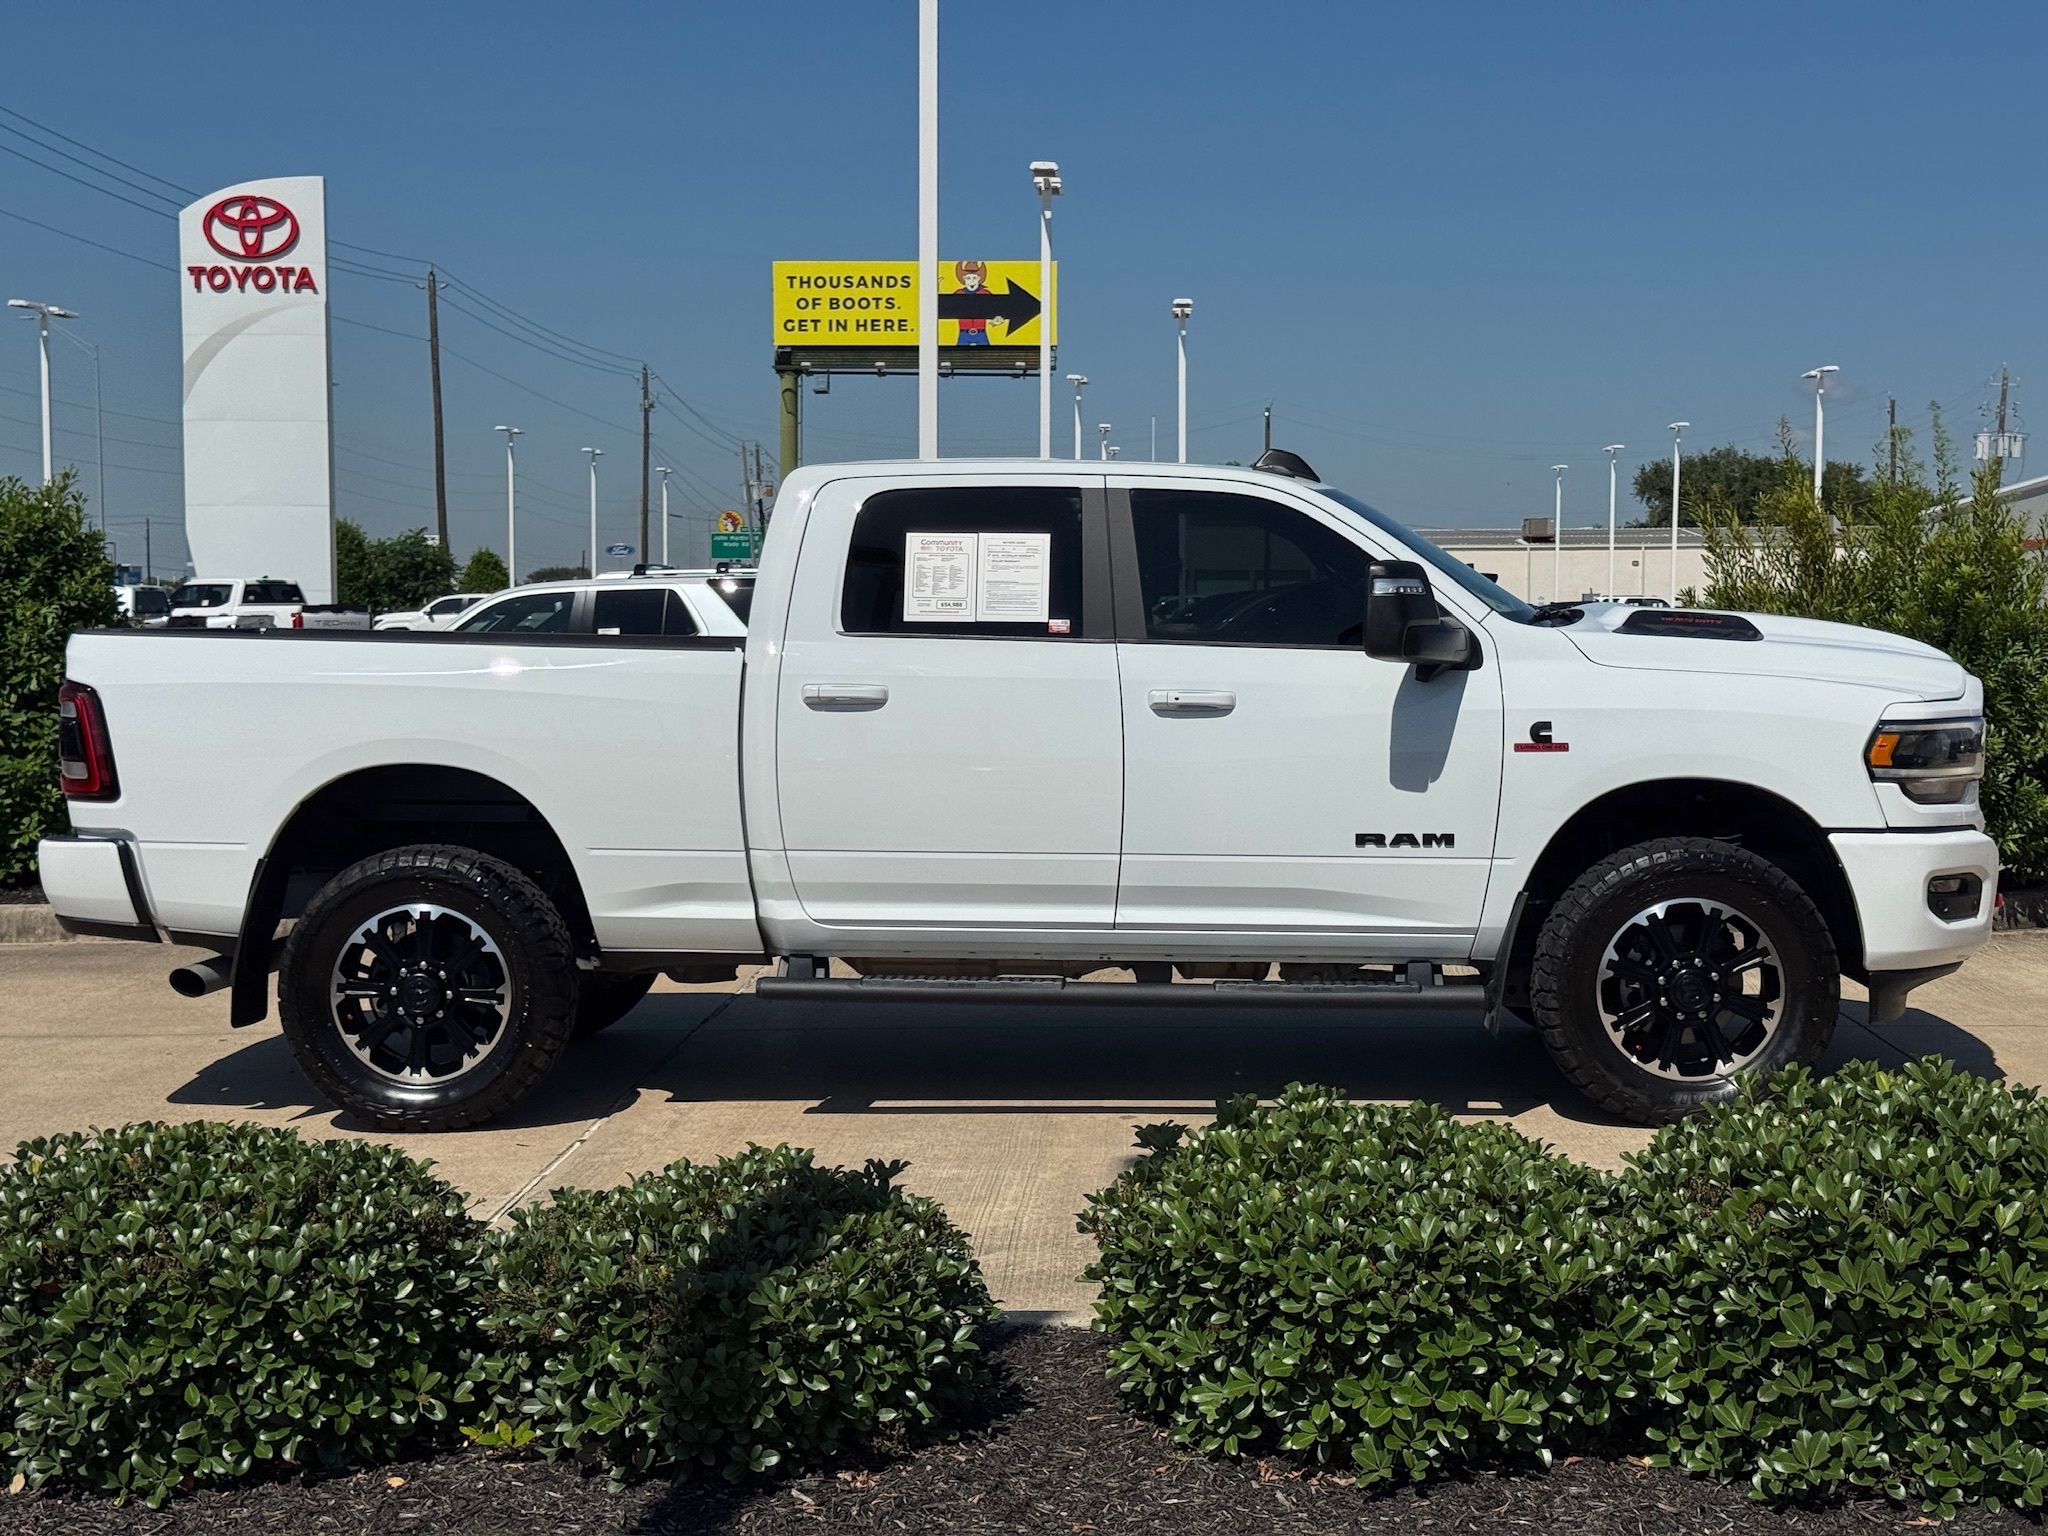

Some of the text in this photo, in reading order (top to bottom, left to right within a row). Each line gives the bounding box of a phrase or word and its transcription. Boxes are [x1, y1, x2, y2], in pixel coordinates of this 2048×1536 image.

[187, 266, 317, 292] TOYOTA
[786, 275, 912, 289] THOUSANDS
[796, 297, 902, 310] OF BOOTS.
[783, 319, 915, 332] GET IN HERE.
[1355, 833, 1455, 848] RAM
